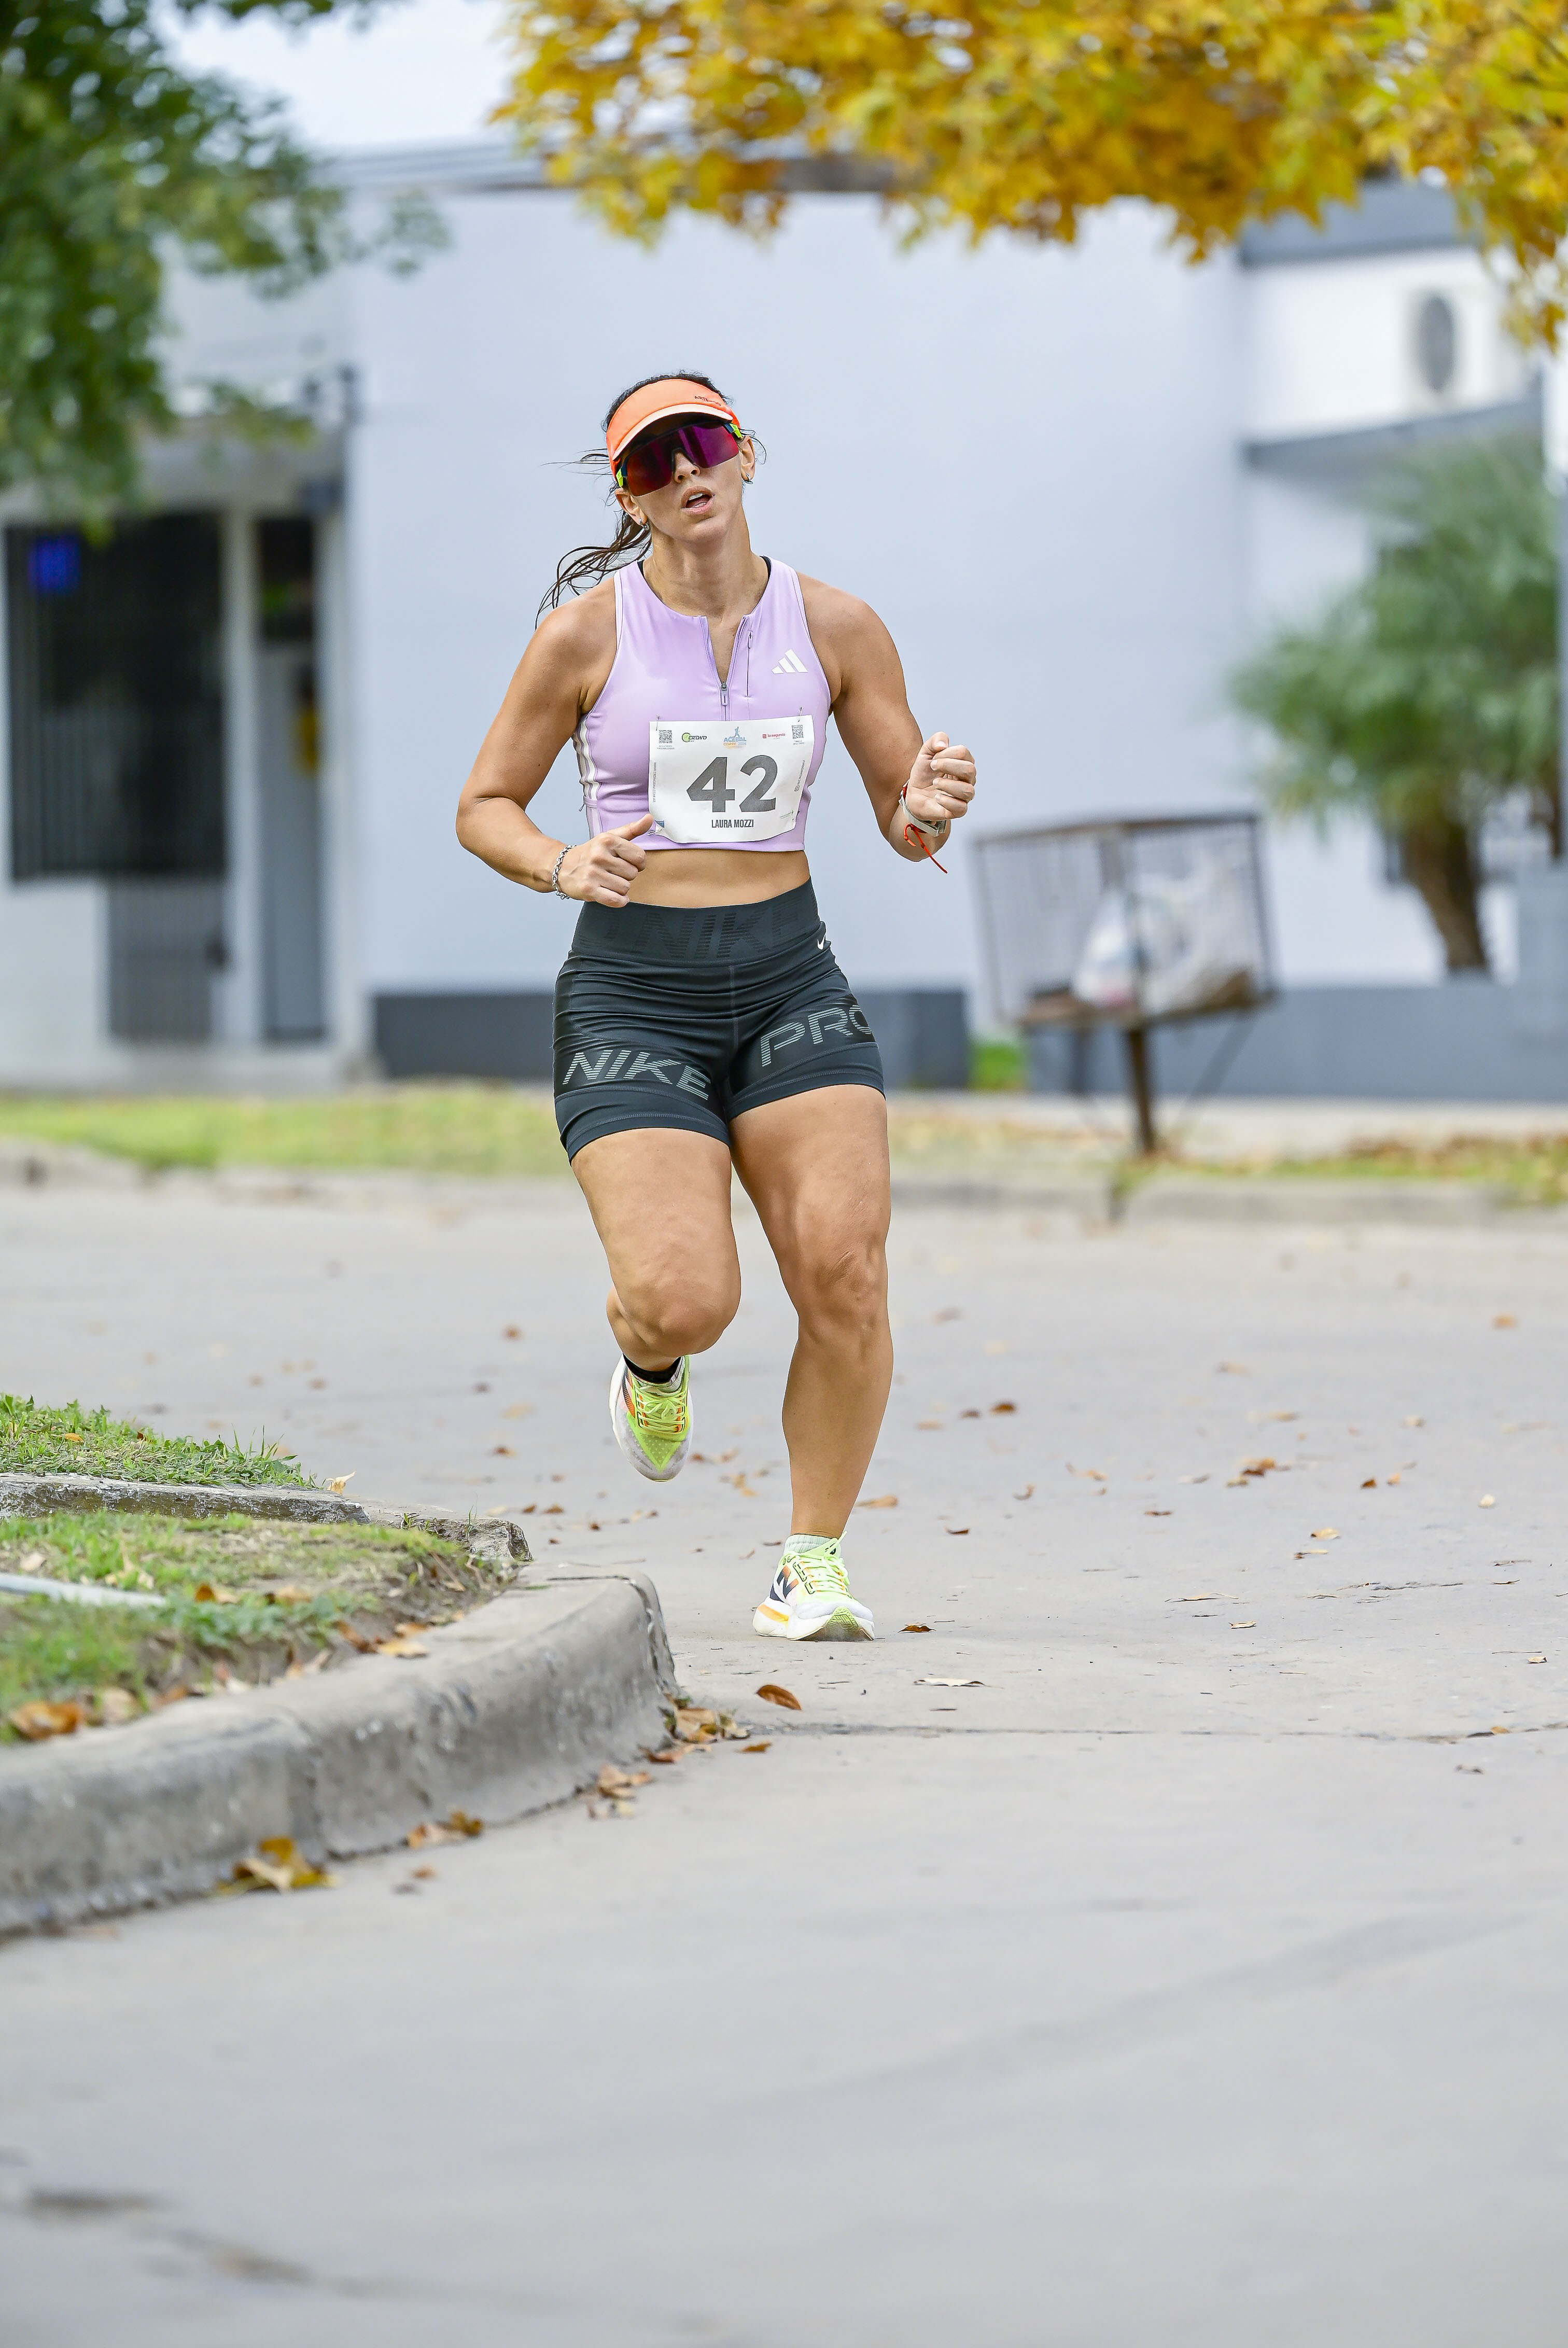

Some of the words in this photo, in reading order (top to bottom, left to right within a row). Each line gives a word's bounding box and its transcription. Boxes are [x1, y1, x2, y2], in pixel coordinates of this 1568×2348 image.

[686, 754, 778, 813] 42
[711, 819, 732, 828] LAURA
[734, 819, 754, 828] MOZZI
[760, 1004, 873, 1067] PRO
[562, 1049, 711, 1100] NIKE
